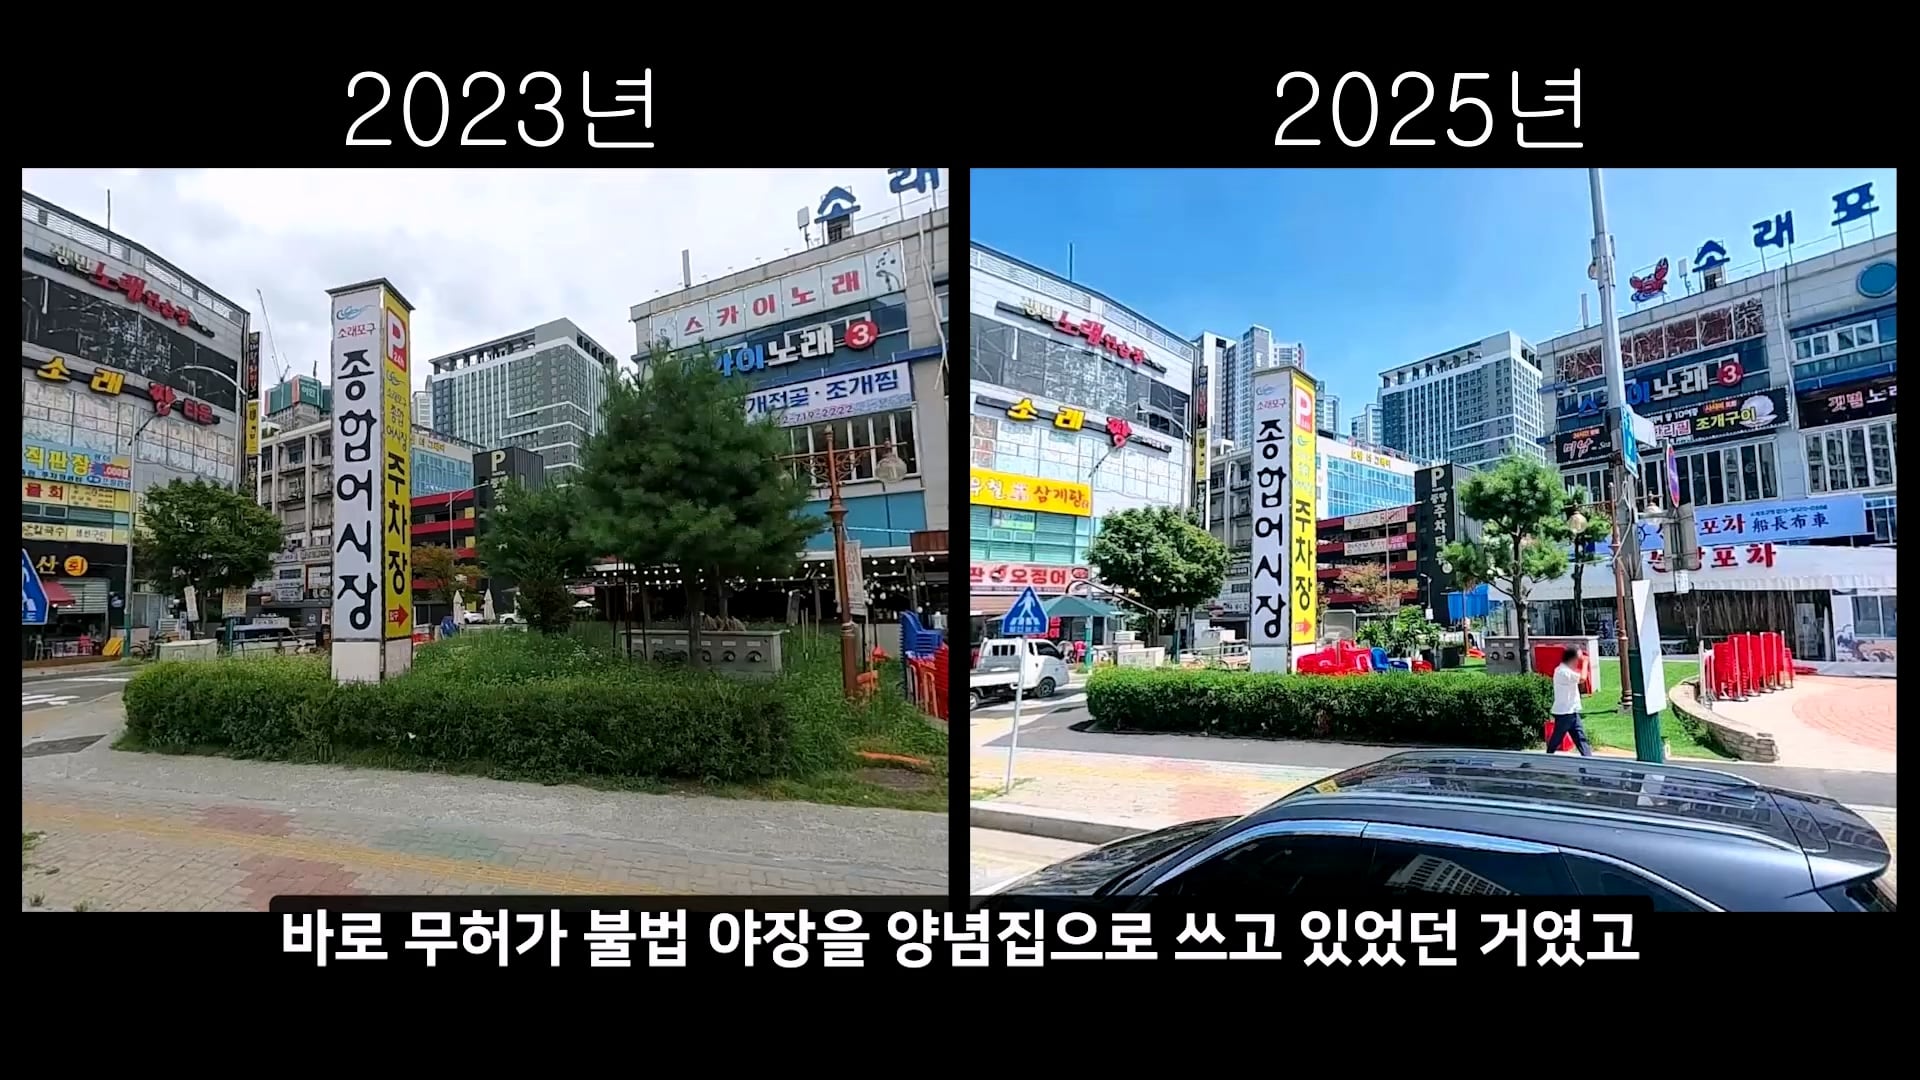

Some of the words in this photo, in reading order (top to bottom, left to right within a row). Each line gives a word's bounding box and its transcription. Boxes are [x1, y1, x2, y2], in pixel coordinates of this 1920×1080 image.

[684, 269, 861, 337] 스카이노래
[336, 323, 377, 339] 소래포구
[826, 369, 898, 401] 조개찜
[1695, 406, 1756, 431] 조개구이
[491, 450, 507, 472] P
[335, 348, 378, 632] 종합어시장
[1431, 467, 1446, 488] P
[386, 452, 408, 596] 주차장
[1254, 417, 1288, 639] 종합어시장
[1295, 498, 1313, 611] 주차장
[1010, 568, 1066, 586] 오징어
